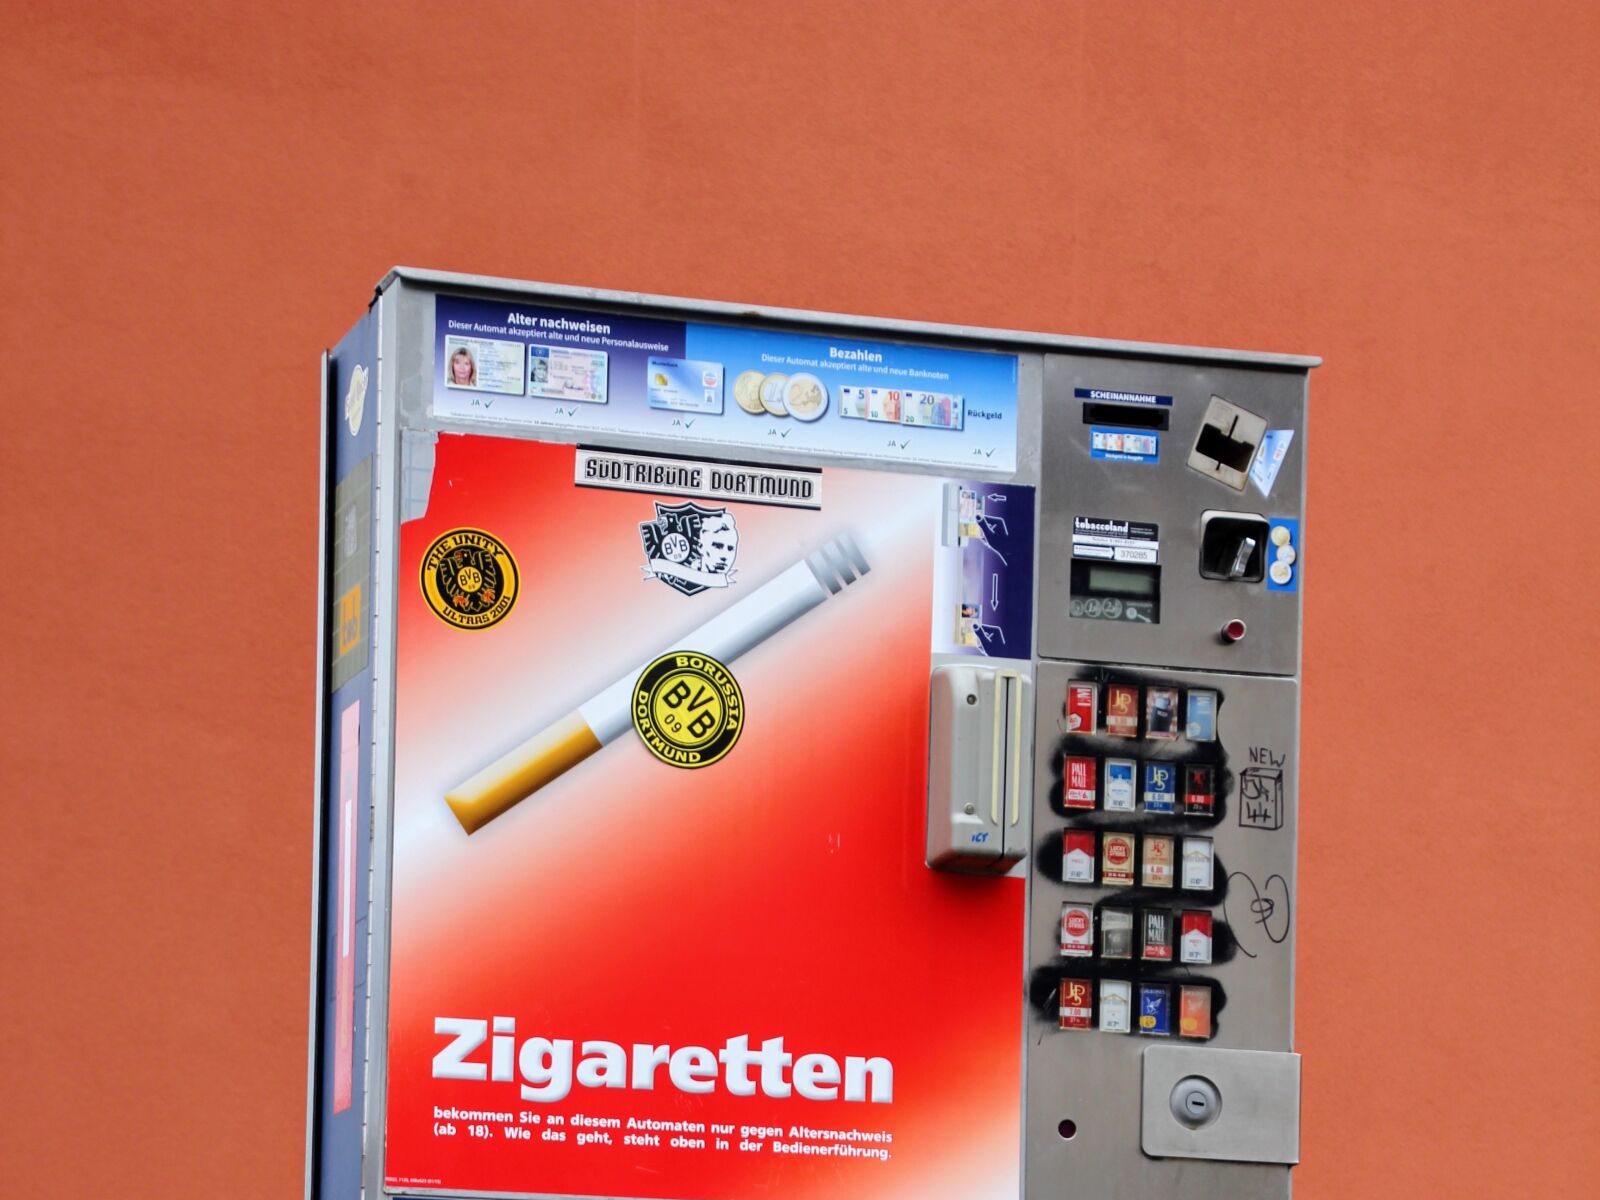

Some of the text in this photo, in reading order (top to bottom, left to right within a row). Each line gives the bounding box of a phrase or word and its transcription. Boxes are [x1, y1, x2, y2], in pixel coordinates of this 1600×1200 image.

[507, 312, 611, 335] Alter nachweisen
[448, 320, 669, 352] Dieser Automat akzeptiert alte und neue Personalausweise
[829, 346, 882, 363] Bezahlen
[761, 353, 949, 380] Dieser Automat akzeptiert alte und neue Banknoten
[858, 389, 865, 399] 5
[888, 391, 900, 401] 10
[920, 394, 934, 405] 20
[1090, 390, 1157, 403] SCHEINANNAHME
[967, 409, 1002, 420] Rückgeld
[585, 457, 814, 498] SÜDTRIBÜNE DORTMUND
[1075, 517, 1129, 533] tobaccoland
[427, 534, 504, 571] THE UNITY
[664, 535, 688, 555] BVB
[459, 568, 480, 586] BVB
[443, 595, 511, 625] ULTRAS 2001
[675, 656, 739, 731] BORUSSIA
[662, 680, 716, 739] BVB
[637, 690, 701, 763] DORTMUND
[664, 713, 682, 733] 09
[1249, 746, 1286, 767] NEW
[1071, 762, 1086, 775] PALL
[1149, 766, 1169, 791] JPS
[1071, 775, 1086, 788] MALL
[1148, 914, 1164, 929] PALL
[1148, 928, 1164, 942] MALL
[1066, 982, 1086, 1006] JPS
[432, 1016, 894, 1104] Zigaretten
[433, 1106, 892, 1143] bekommen Sie an diesem Automaten nur gegen Altersnachweis
[433, 1123, 892, 1161] (ab 18). Wie das geht, steht oben in der Bedienerführung.
